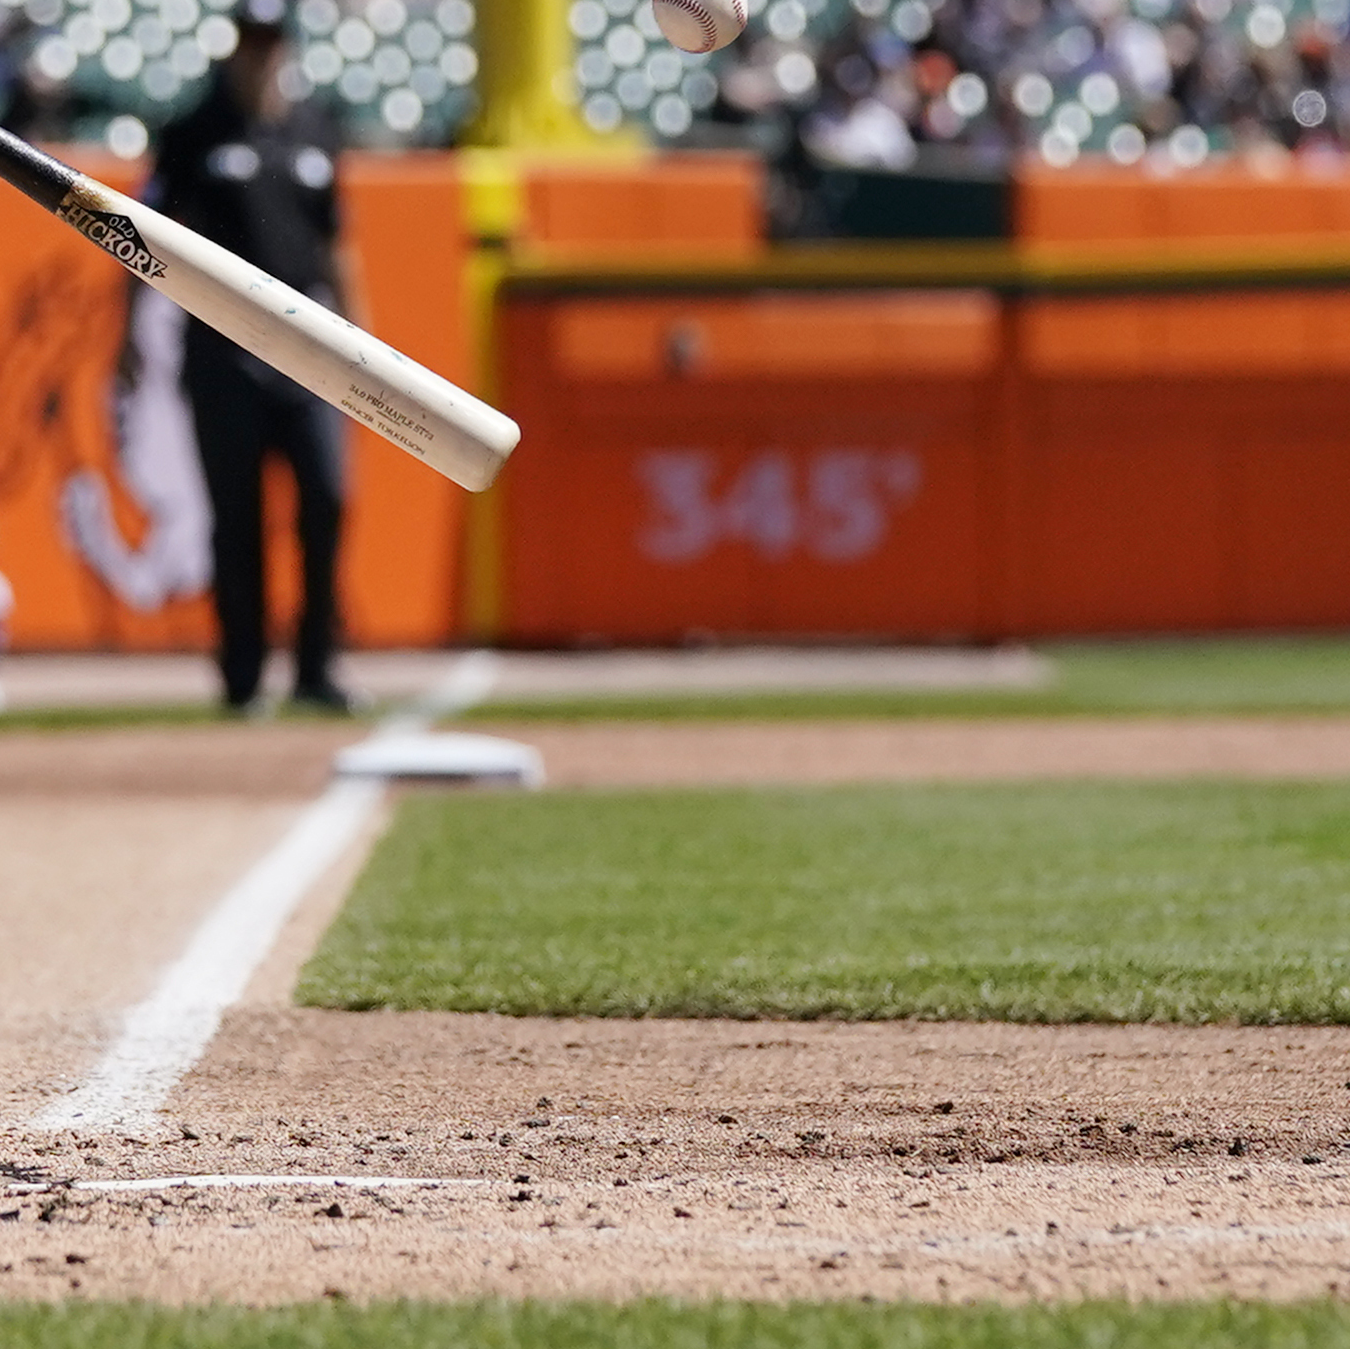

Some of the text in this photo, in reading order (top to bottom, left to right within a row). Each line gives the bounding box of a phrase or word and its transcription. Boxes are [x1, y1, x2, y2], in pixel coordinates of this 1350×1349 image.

[61, 201, 167, 280] HICKORY
[108, 215, 136, 239] OLD
[341, 399, 375, 423] SPENCER
[377, 420, 426, 455] TORKELSON
[366, 393, 385, 410] PRO
[385, 405, 414, 429] MAPLE
